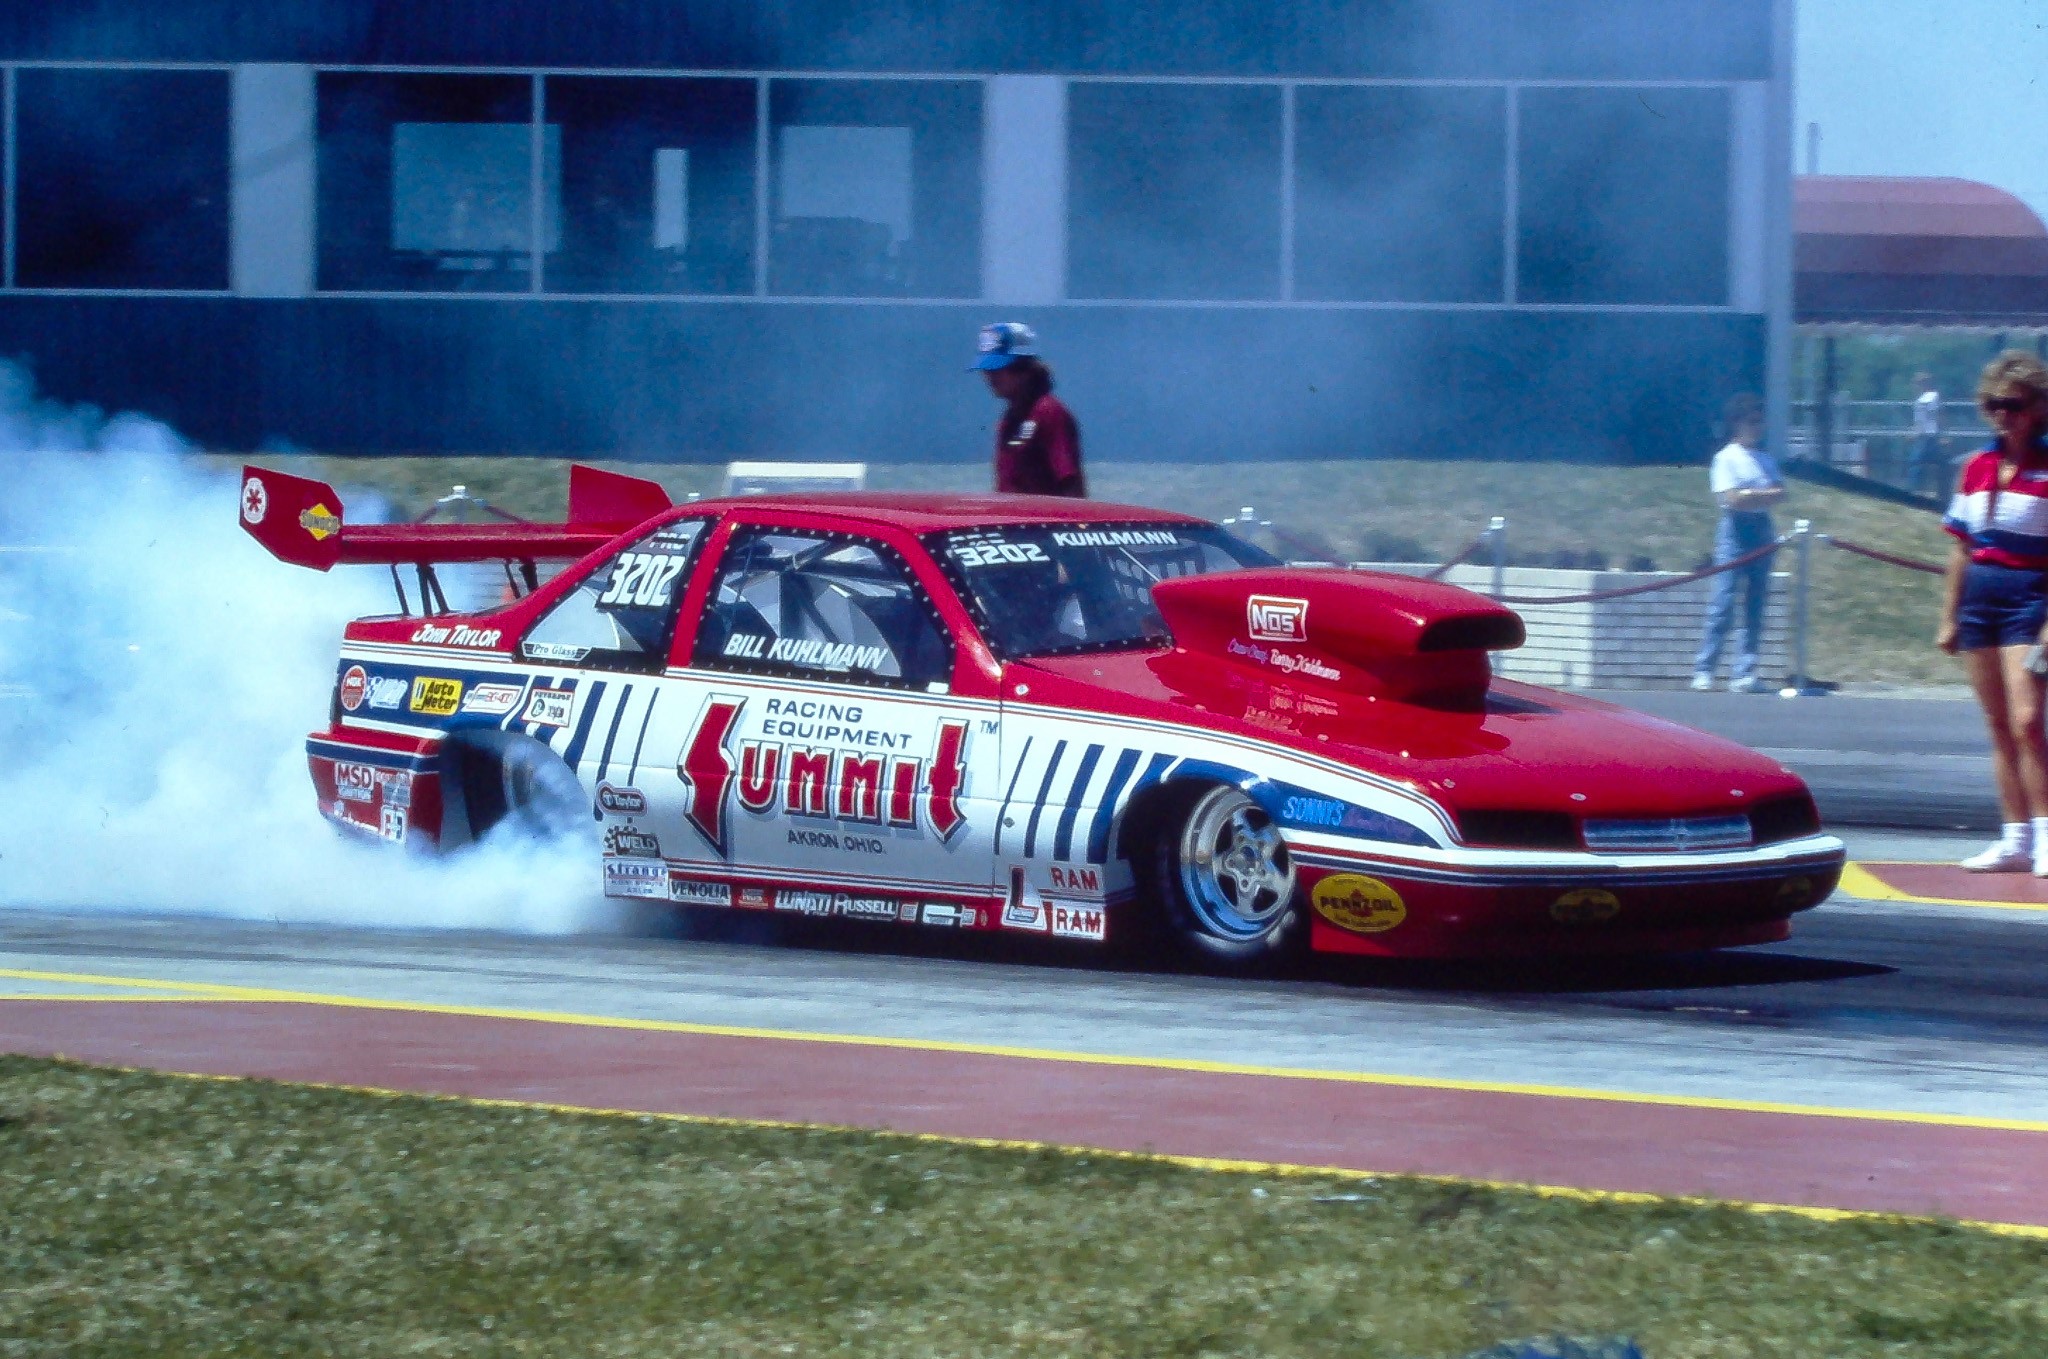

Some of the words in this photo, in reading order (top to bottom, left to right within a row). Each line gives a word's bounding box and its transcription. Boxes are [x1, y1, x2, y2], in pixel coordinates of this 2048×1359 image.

[1052, 531, 1179, 547] KUHLMANN
[954, 543, 1050, 567] 3202
[600, 552, 686, 606] 3202
[1252, 604, 1300, 633] NOS
[412, 623, 450, 643] JOHN
[449, 625, 502, 648] TAYLOR
[533, 643, 549, 654] Pro
[551, 645, 577, 658] Glass
[723, 633, 767, 658] BILL
[767, 637, 888, 669] KUHLMANN
[427, 681, 455, 696] Auto
[423, 695, 457, 710] Meter
[766, 698, 863, 723] RACING
[762, 719, 912, 749] EQUIPMENT
[980, 719, 999, 734] TM
[337, 763, 372, 788] MSD
[618, 834, 657, 850] WELD
[787, 829, 840, 849] AKRON
[670, 880, 730, 899] VENOLIA
[1050, 866, 1099, 891] RAM
[1056, 907, 1102, 934] RAM
